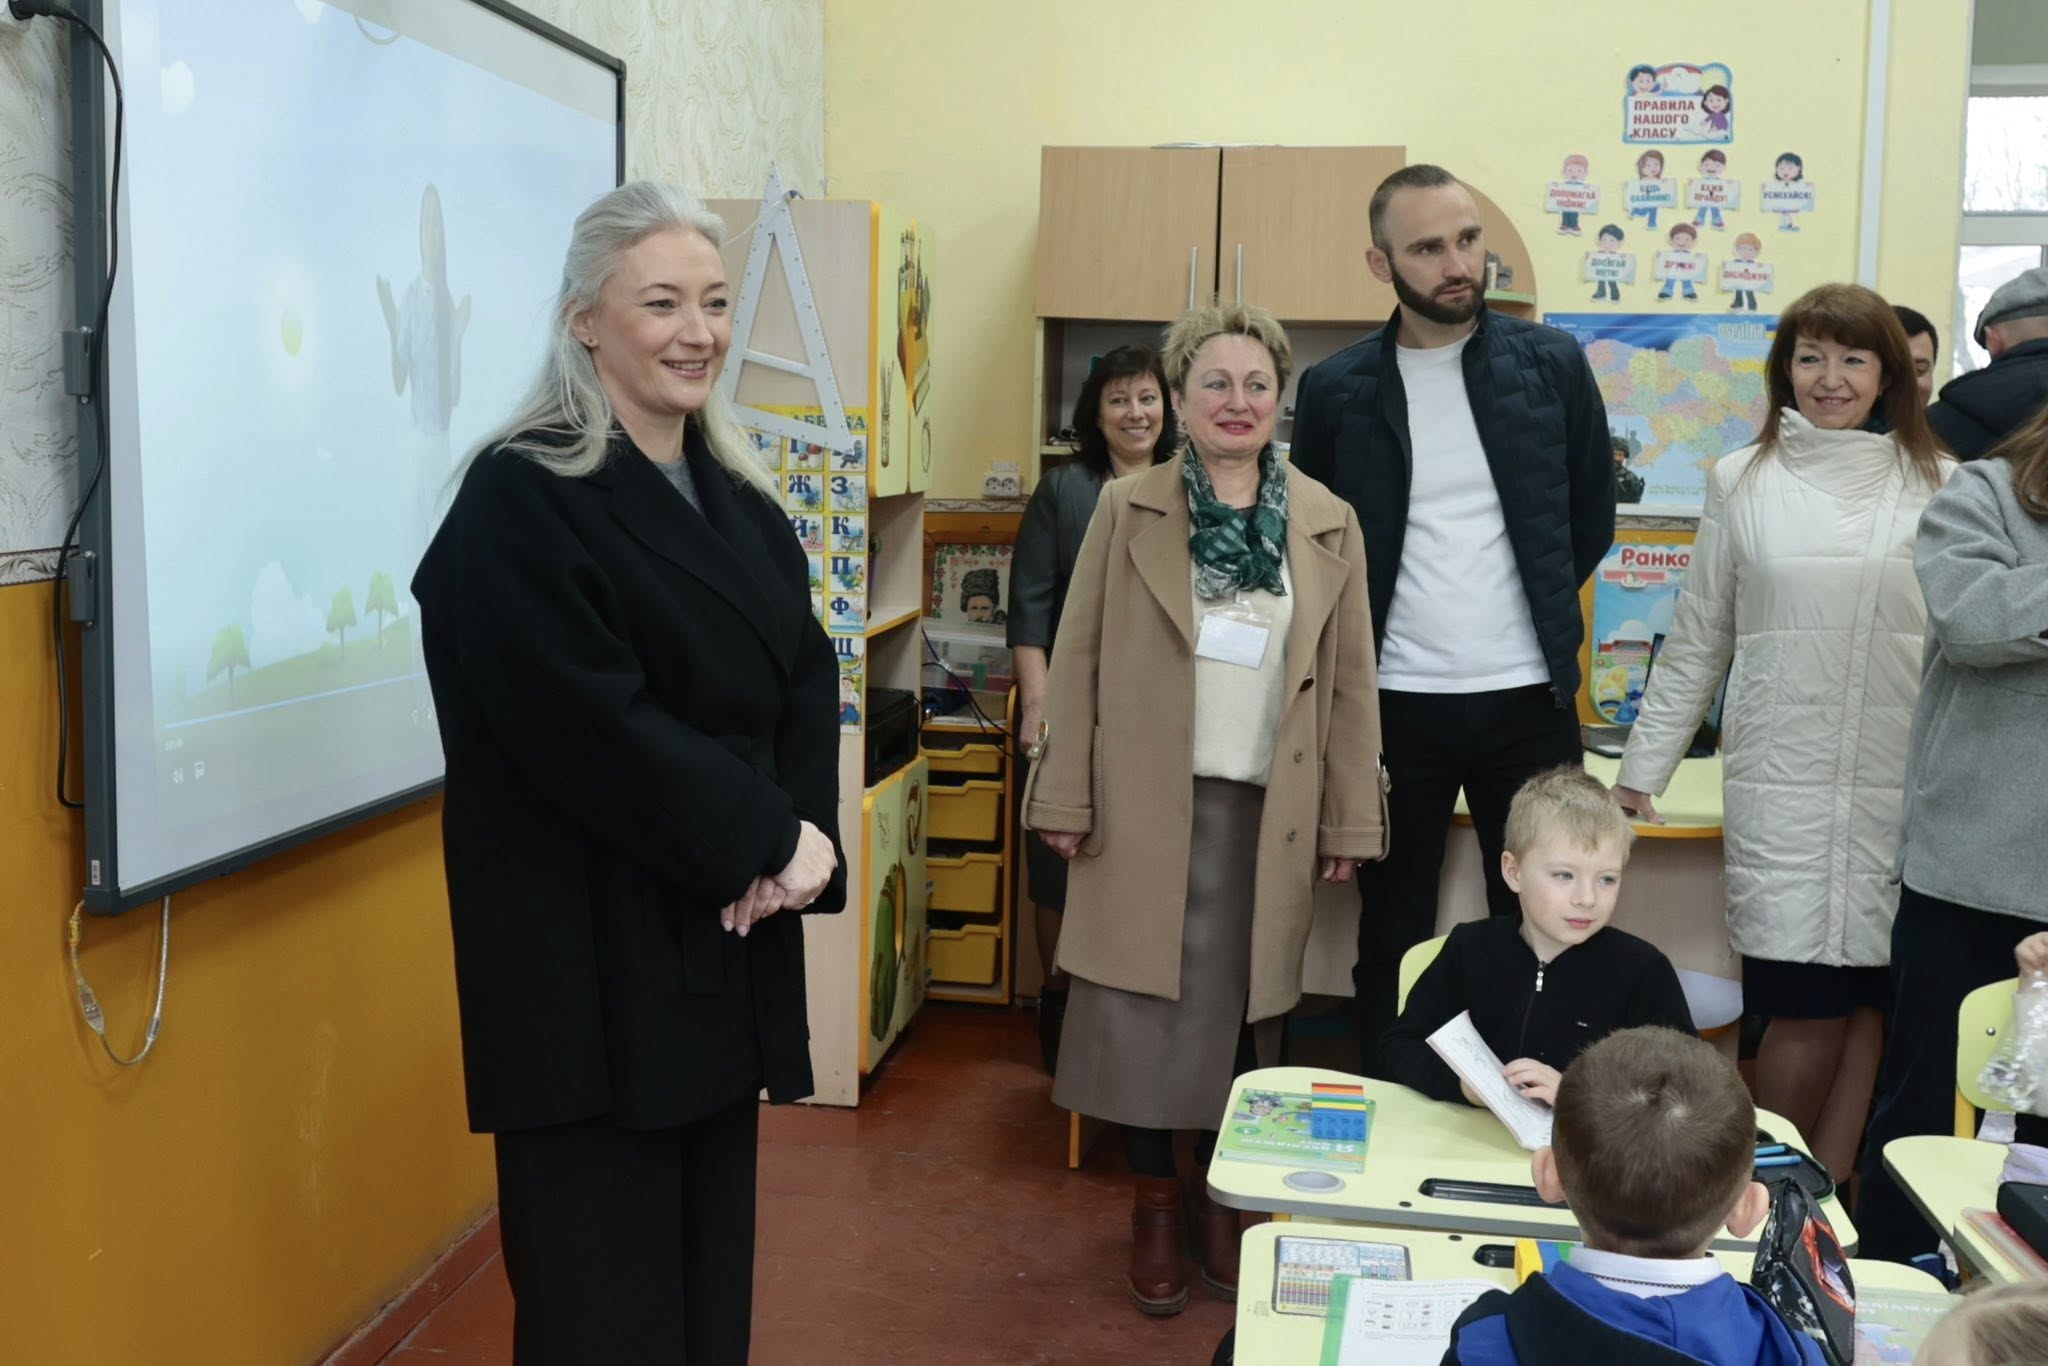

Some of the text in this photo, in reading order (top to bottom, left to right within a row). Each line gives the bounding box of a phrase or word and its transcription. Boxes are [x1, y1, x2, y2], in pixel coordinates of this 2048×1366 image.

[1634, 100, 1695, 110] ПРАВИЛА
[1633, 114, 1689, 125] НАШОГО
[1632, 127, 1677, 138] КЛАСУ
[1549, 188, 1597, 200] ДОПОМАГАЙ
[1763, 191, 1812, 200] УСМІХАЙСЯ!
[787, 475, 811, 493] Ж
[831, 475, 848, 494] З
[831, 516, 850, 535] К
[831, 556, 850, 575] П
[830, 597, 850, 615] Ф
